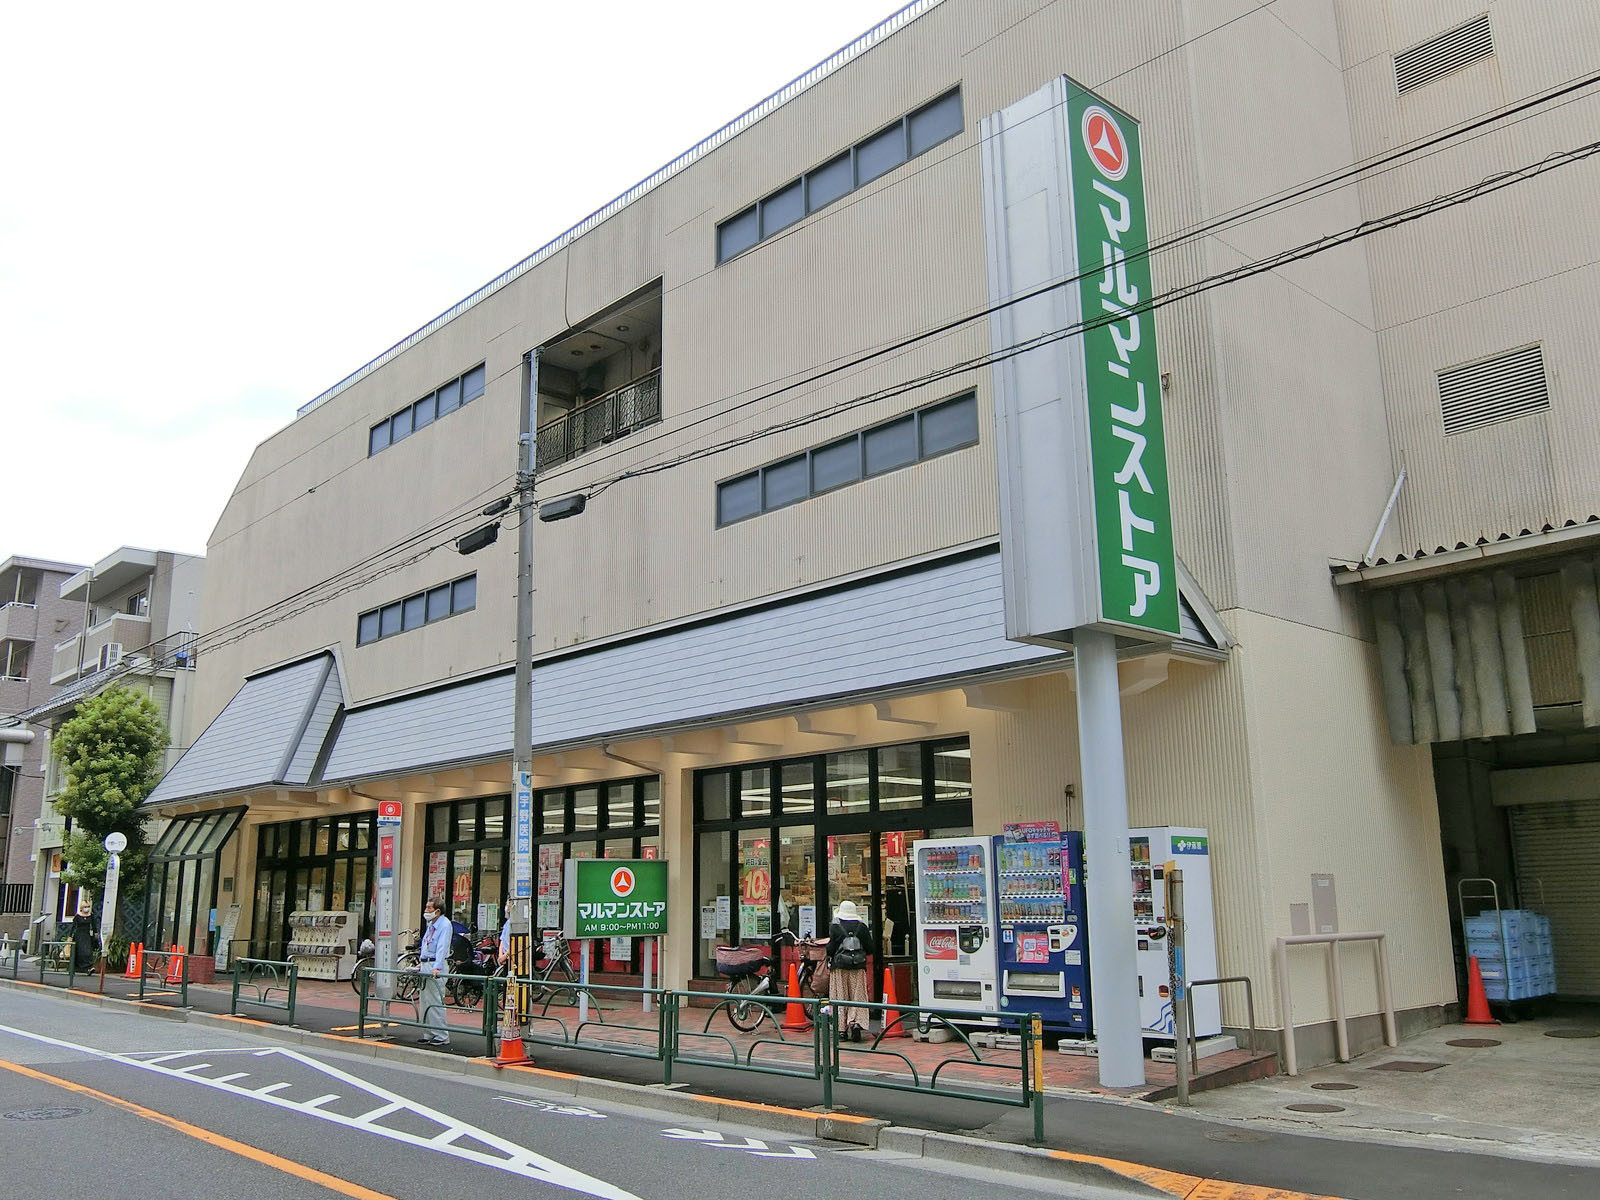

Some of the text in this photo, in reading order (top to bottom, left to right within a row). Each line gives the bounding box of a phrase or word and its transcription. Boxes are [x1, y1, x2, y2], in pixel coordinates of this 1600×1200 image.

[1092, 178, 1161, 618] マルマンストア
[577, 902, 666, 919] マルマンストア
[584, 924, 598, 932] AM
